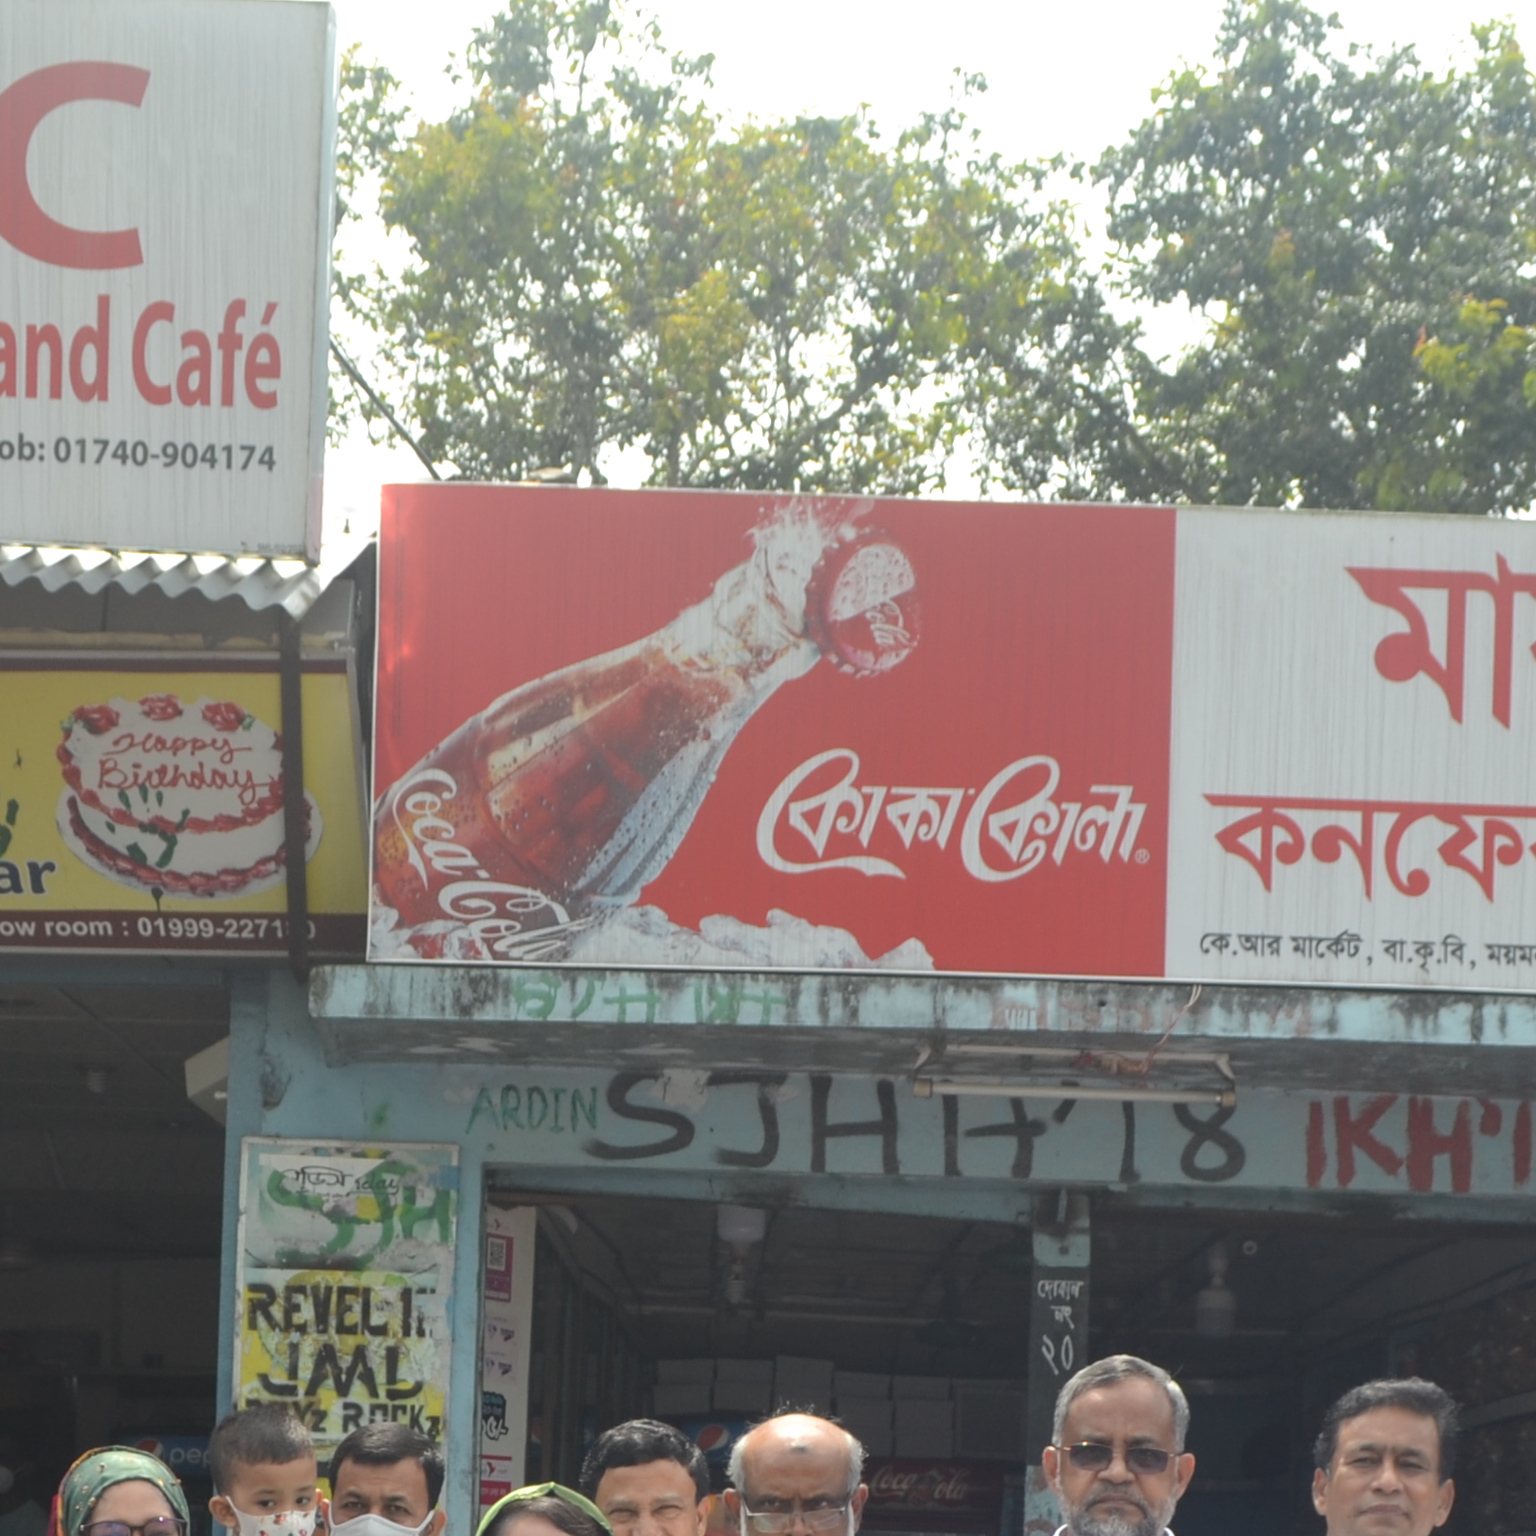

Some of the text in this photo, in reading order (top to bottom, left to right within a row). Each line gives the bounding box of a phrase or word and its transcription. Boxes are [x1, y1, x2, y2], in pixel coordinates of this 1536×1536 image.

[132, 297, 281, 409] Café
[52, 438, 276, 473] 01740-904174
[102, 732, 252, 765] Happy
[98, 757, 270, 806] Birthday
[45, 918, 113, 940] room
[1199, 933, 1282, 961] কে.আর
[1041, 1334, 1073, 1375] ২০
